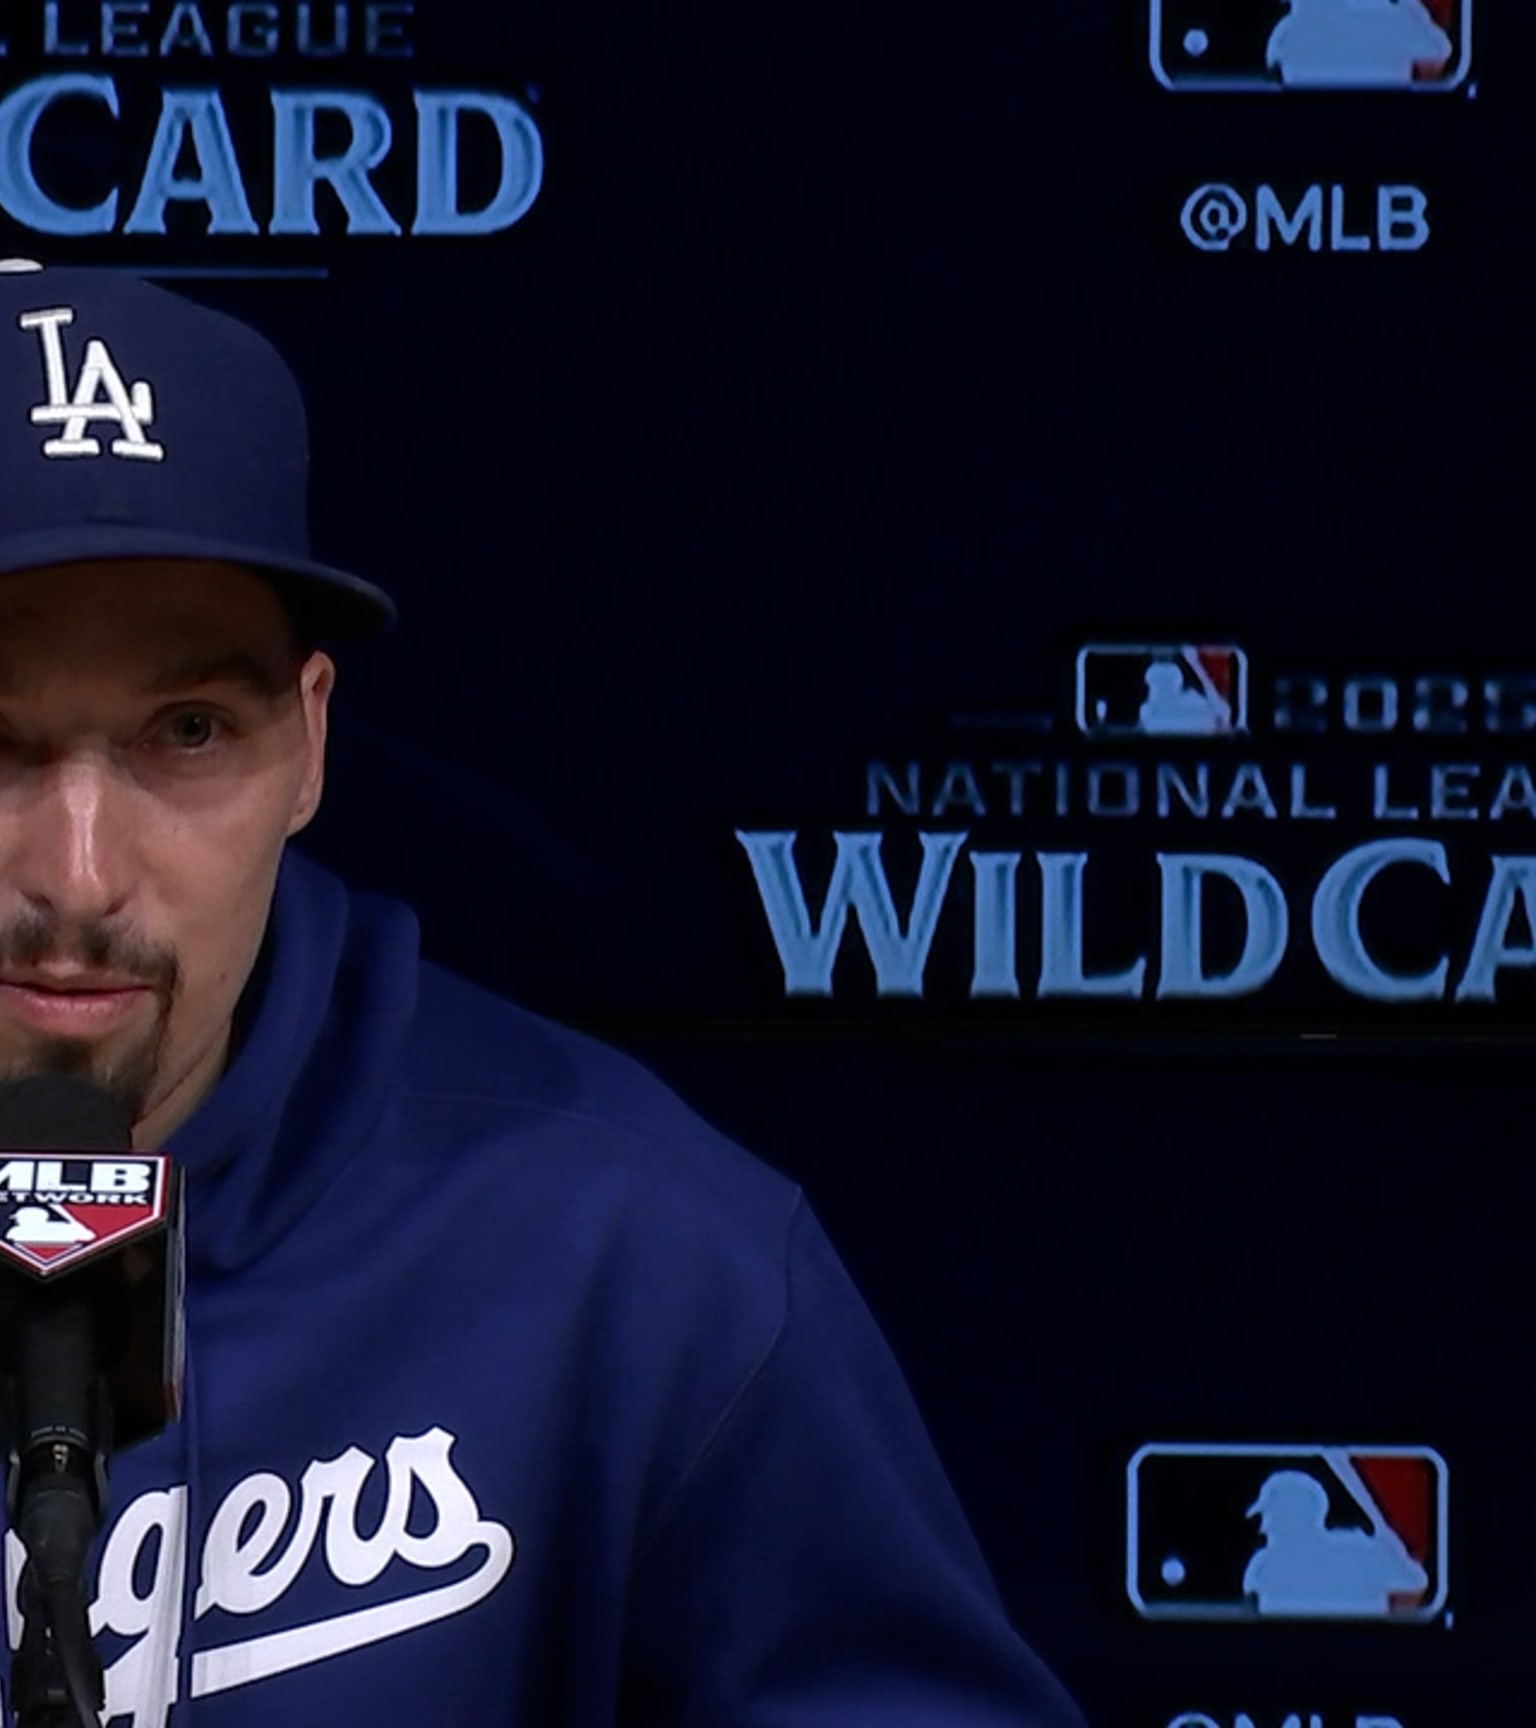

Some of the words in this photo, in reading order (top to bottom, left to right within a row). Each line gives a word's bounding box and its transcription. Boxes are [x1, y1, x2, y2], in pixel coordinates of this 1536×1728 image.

[43, 0, 414, 56] LEAGUE
[1180, 183, 1430, 252] @MLB
[19, 307, 164, 461] LA
[866, 762, 1337, 820] NATIONAL
